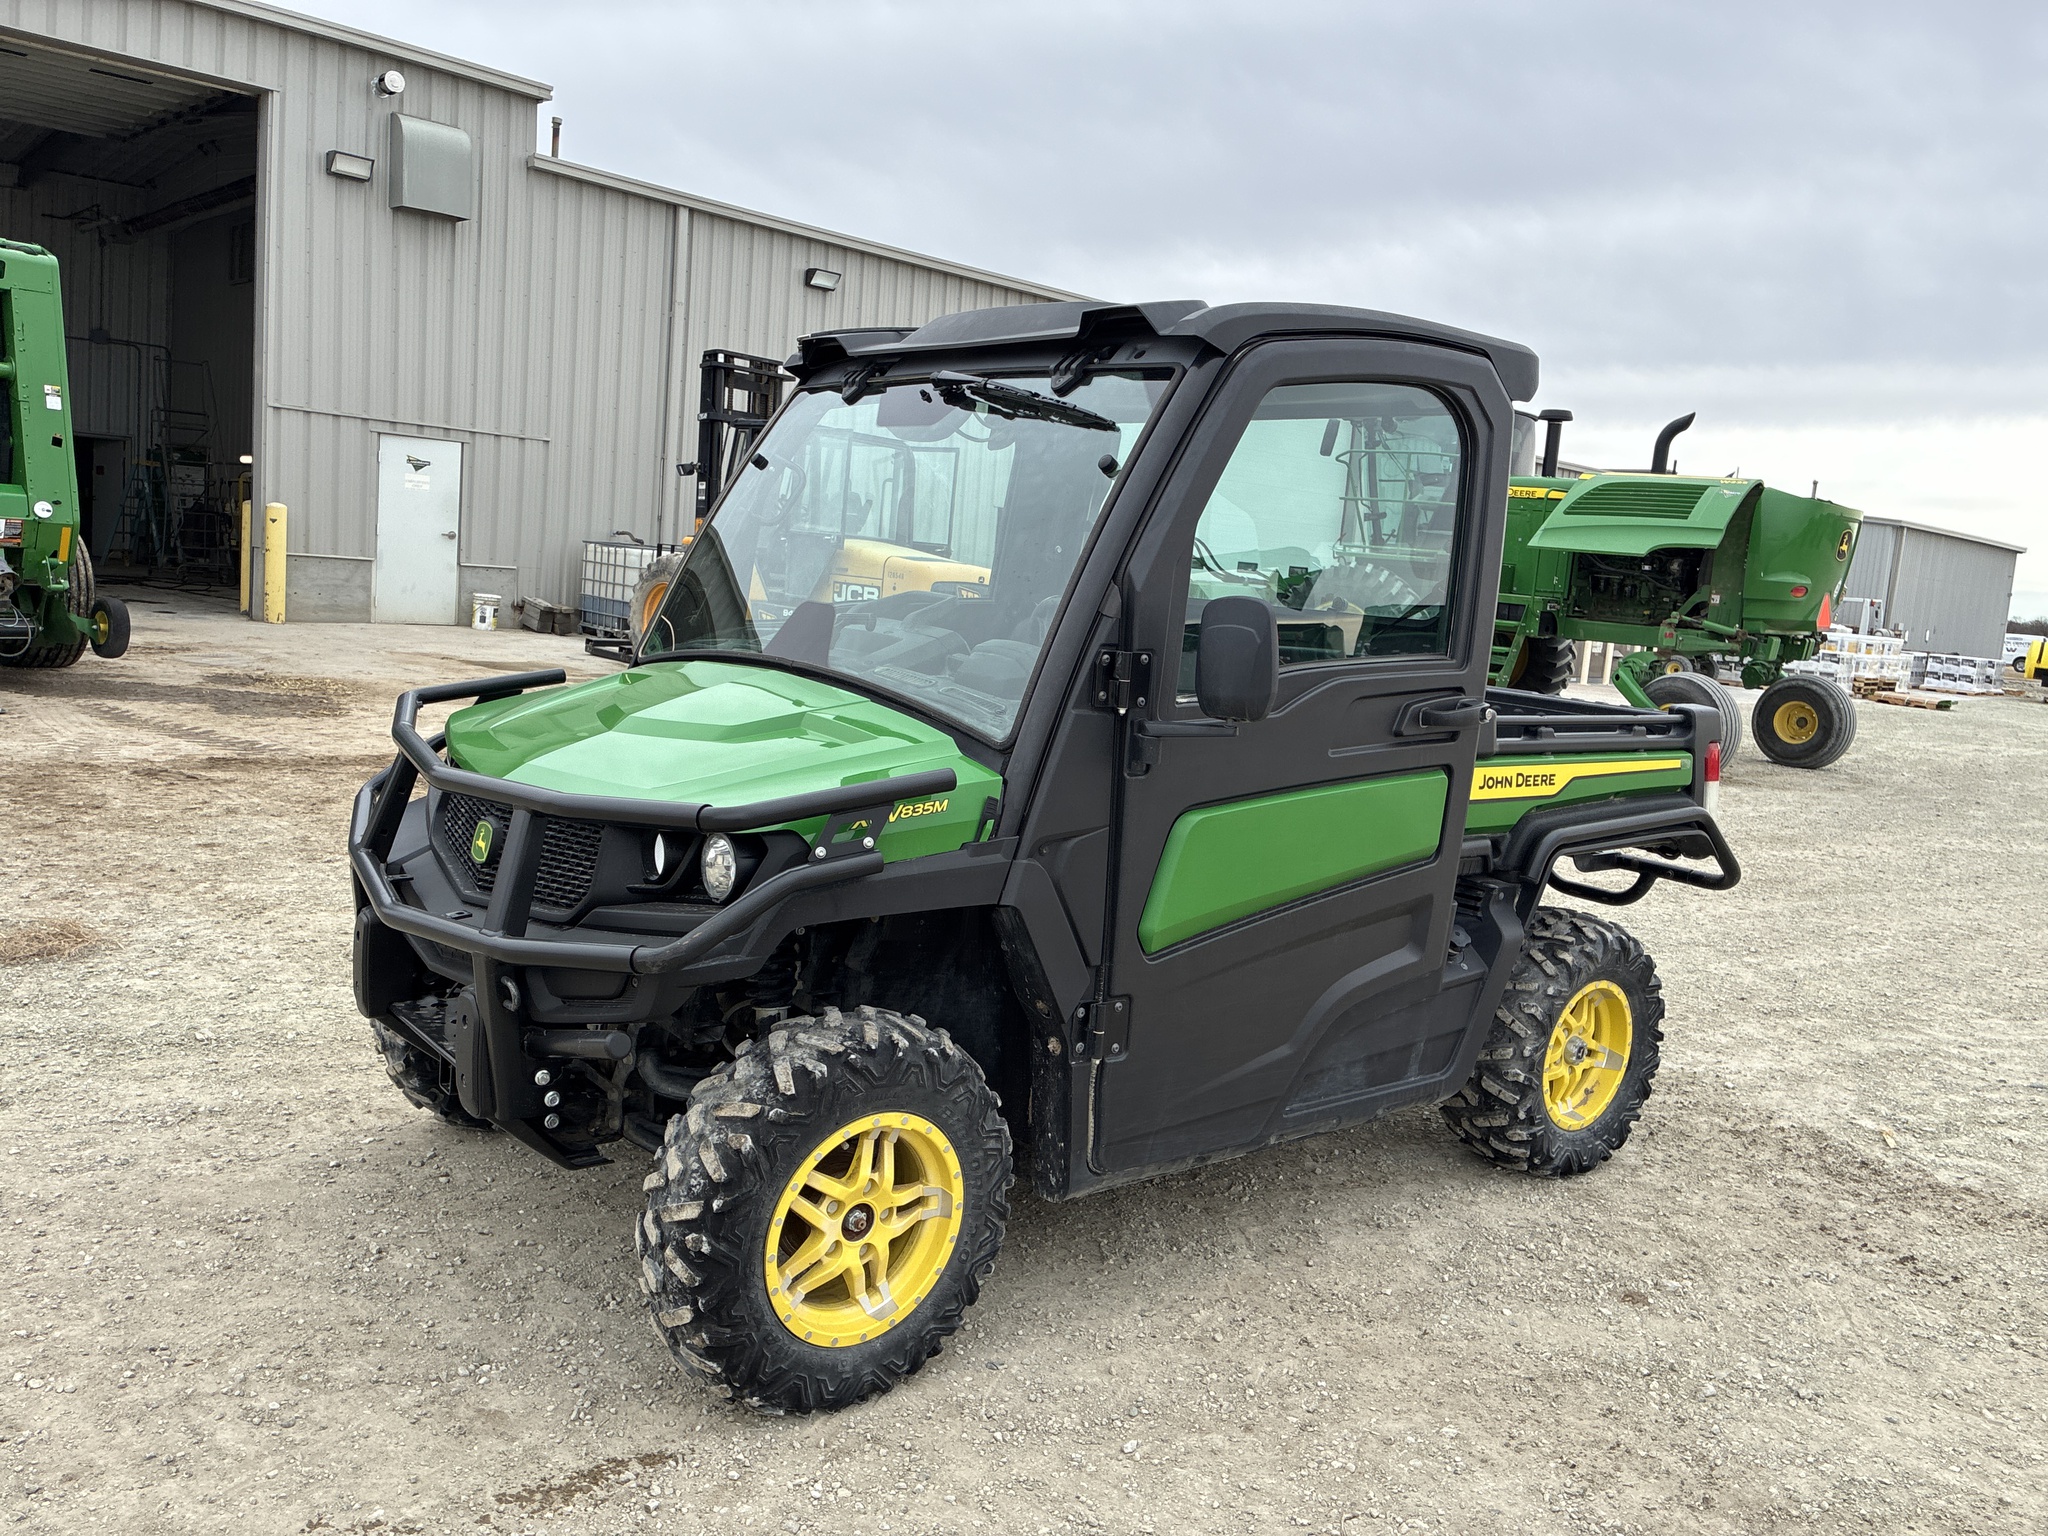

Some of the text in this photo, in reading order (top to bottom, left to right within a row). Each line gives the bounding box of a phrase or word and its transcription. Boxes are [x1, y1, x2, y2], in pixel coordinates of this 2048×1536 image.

[1508, 488, 1537, 498] DEERE
[833, 584, 880, 603] JCB
[1478, 772, 1556, 790] JOHN DEERE
[850, 799, 949, 831] V835M
